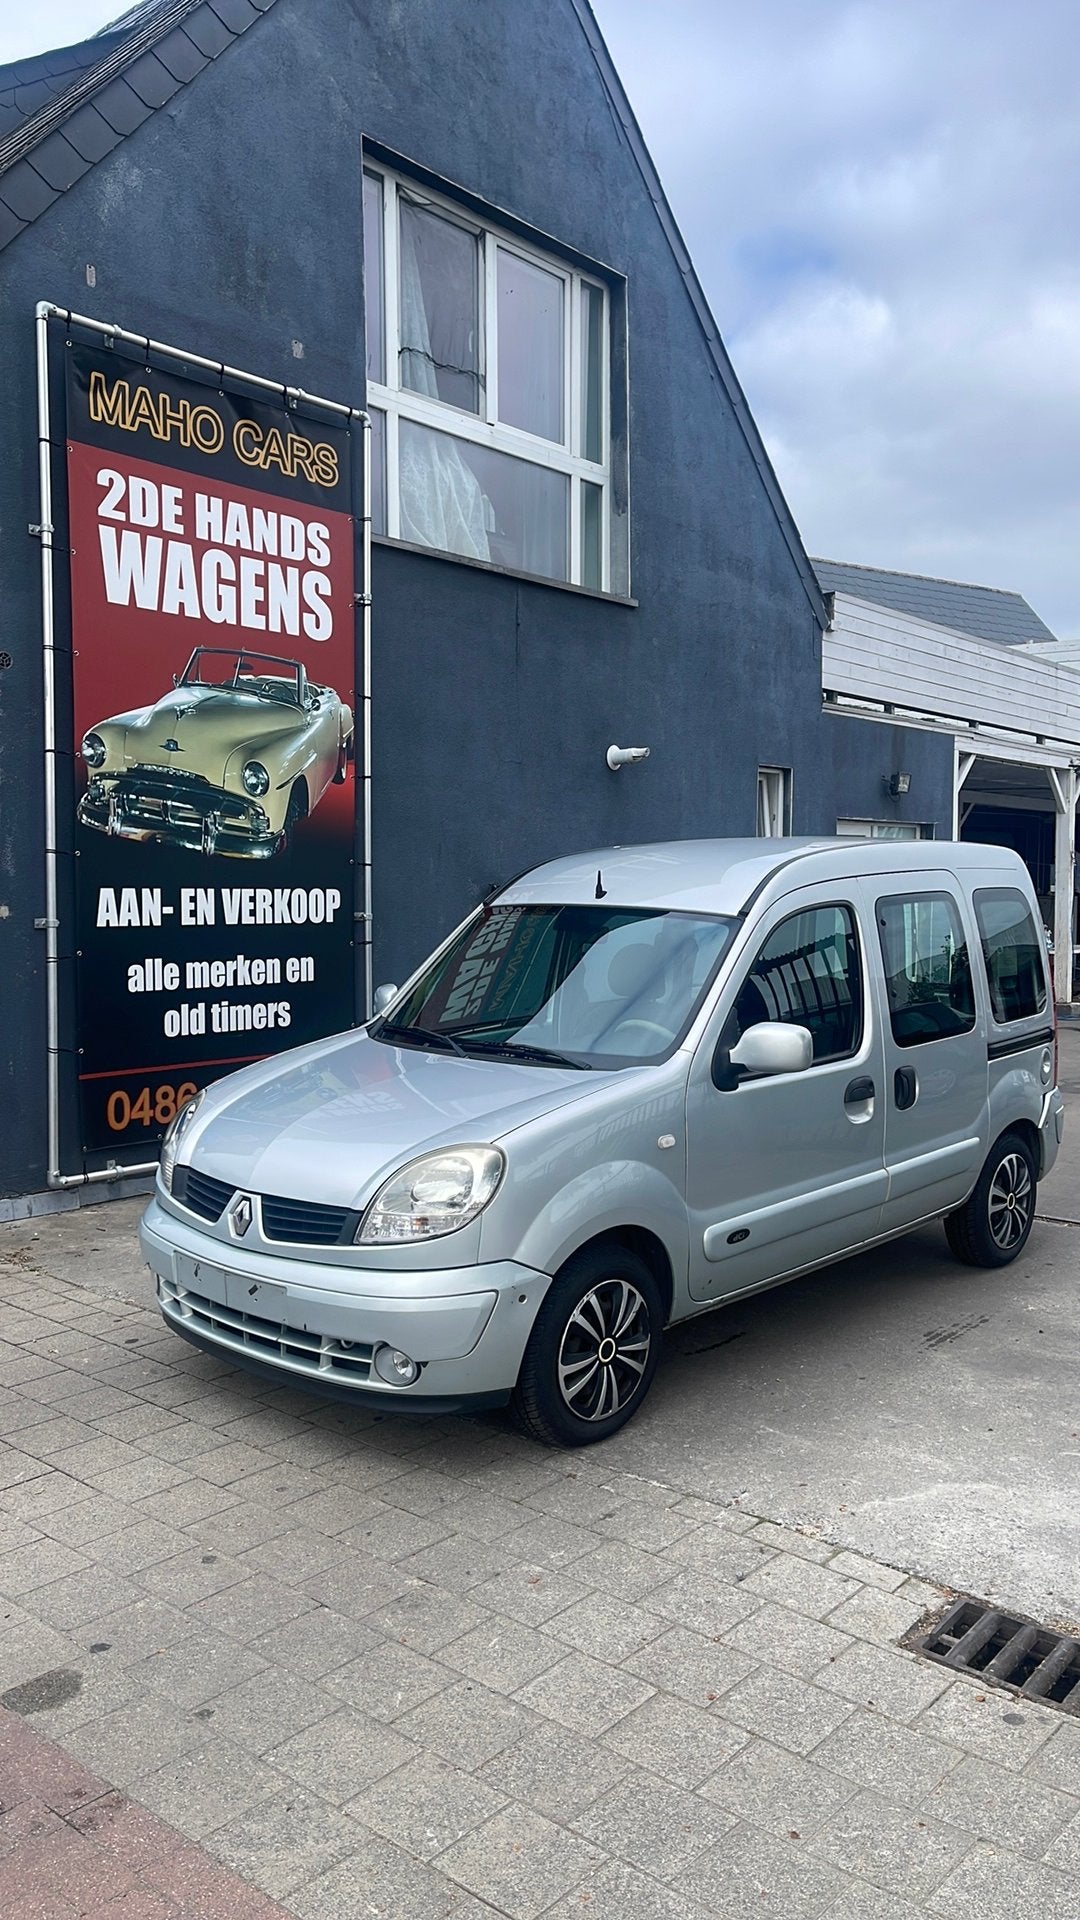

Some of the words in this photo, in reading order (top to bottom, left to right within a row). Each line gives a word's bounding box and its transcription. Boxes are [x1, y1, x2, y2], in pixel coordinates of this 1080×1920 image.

[89, 371, 225, 454] MAHO
[233, 419, 339, 487] CARS
[96, 468, 185, 535] 2DE
[194, 492, 331, 568] HANDS
[98, 523, 334, 642] WAGENS
[96, 887, 174, 927] AAN-
[181, 888, 215, 926] EN
[220, 888, 341, 925] VERKOOP
[127, 958, 180, 993] alle
[185, 955, 281, 989] merken
[286, 956, 315, 983] en
[164, 1002, 206, 1037] old
[211, 1000, 291, 1033] timers
